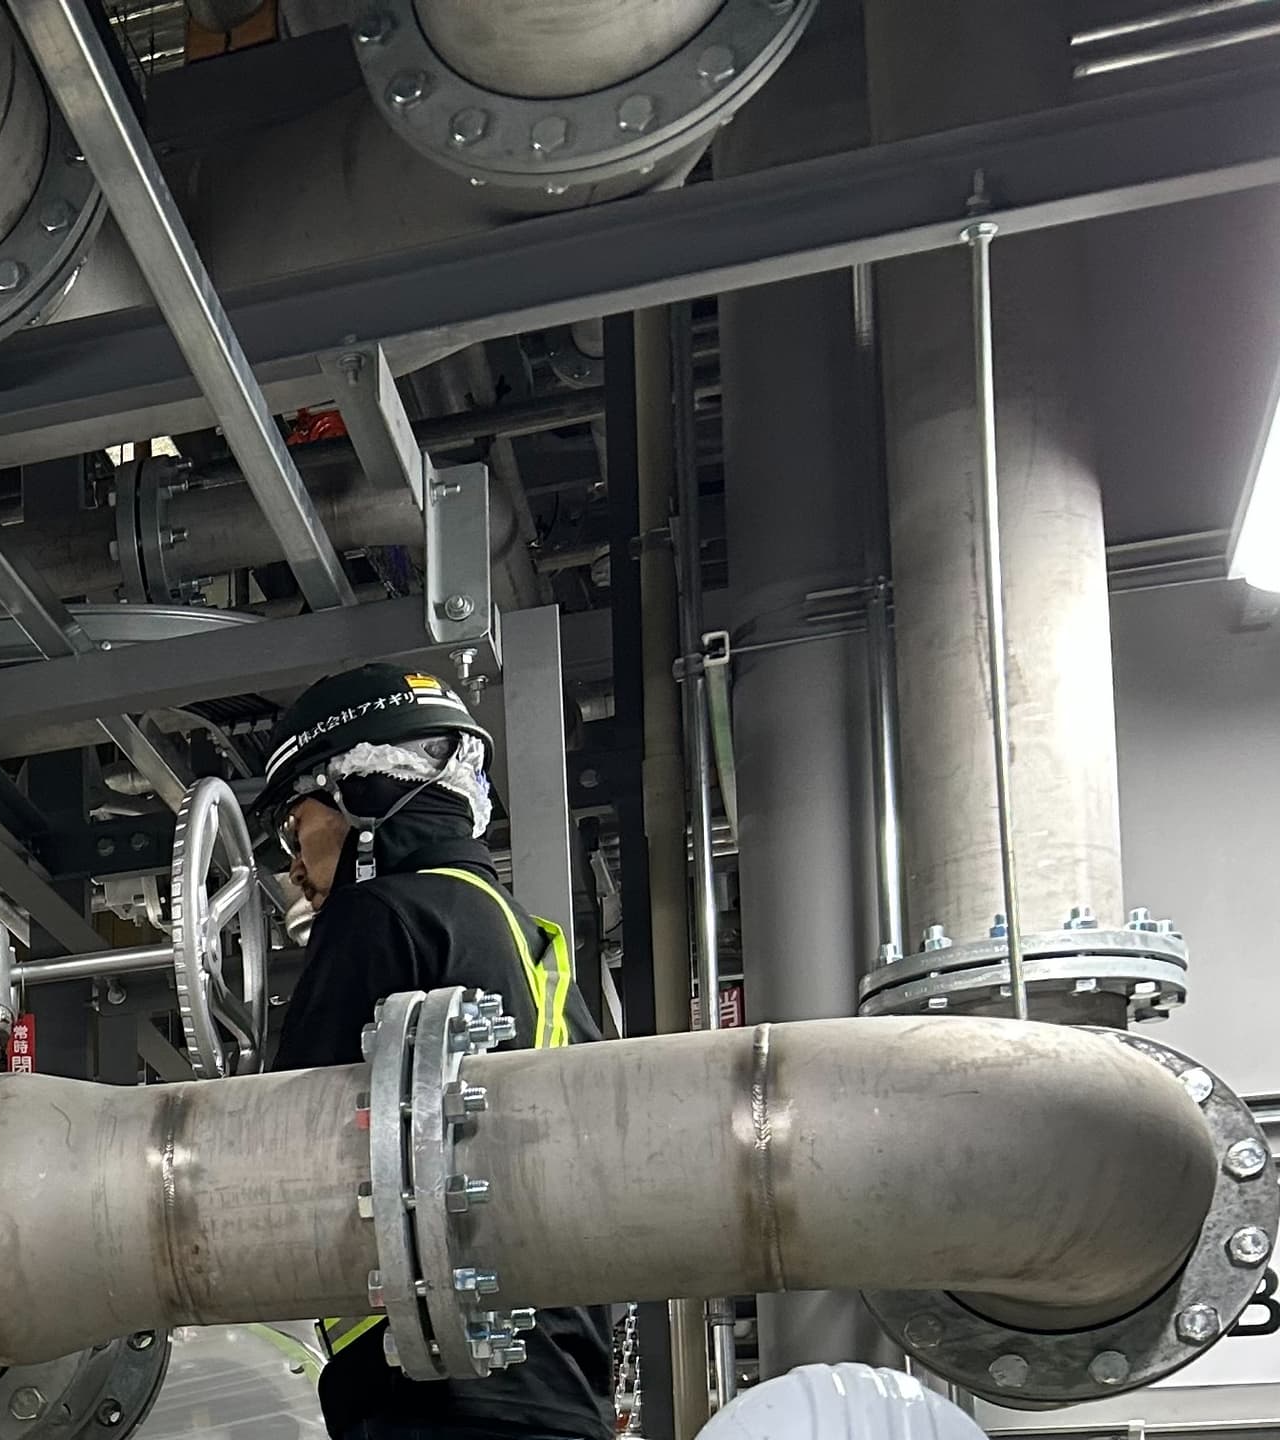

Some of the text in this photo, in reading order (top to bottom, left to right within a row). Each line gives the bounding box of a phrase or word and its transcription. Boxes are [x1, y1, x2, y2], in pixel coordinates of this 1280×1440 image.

[297, 691, 416, 747] 株式会社アオギリ
